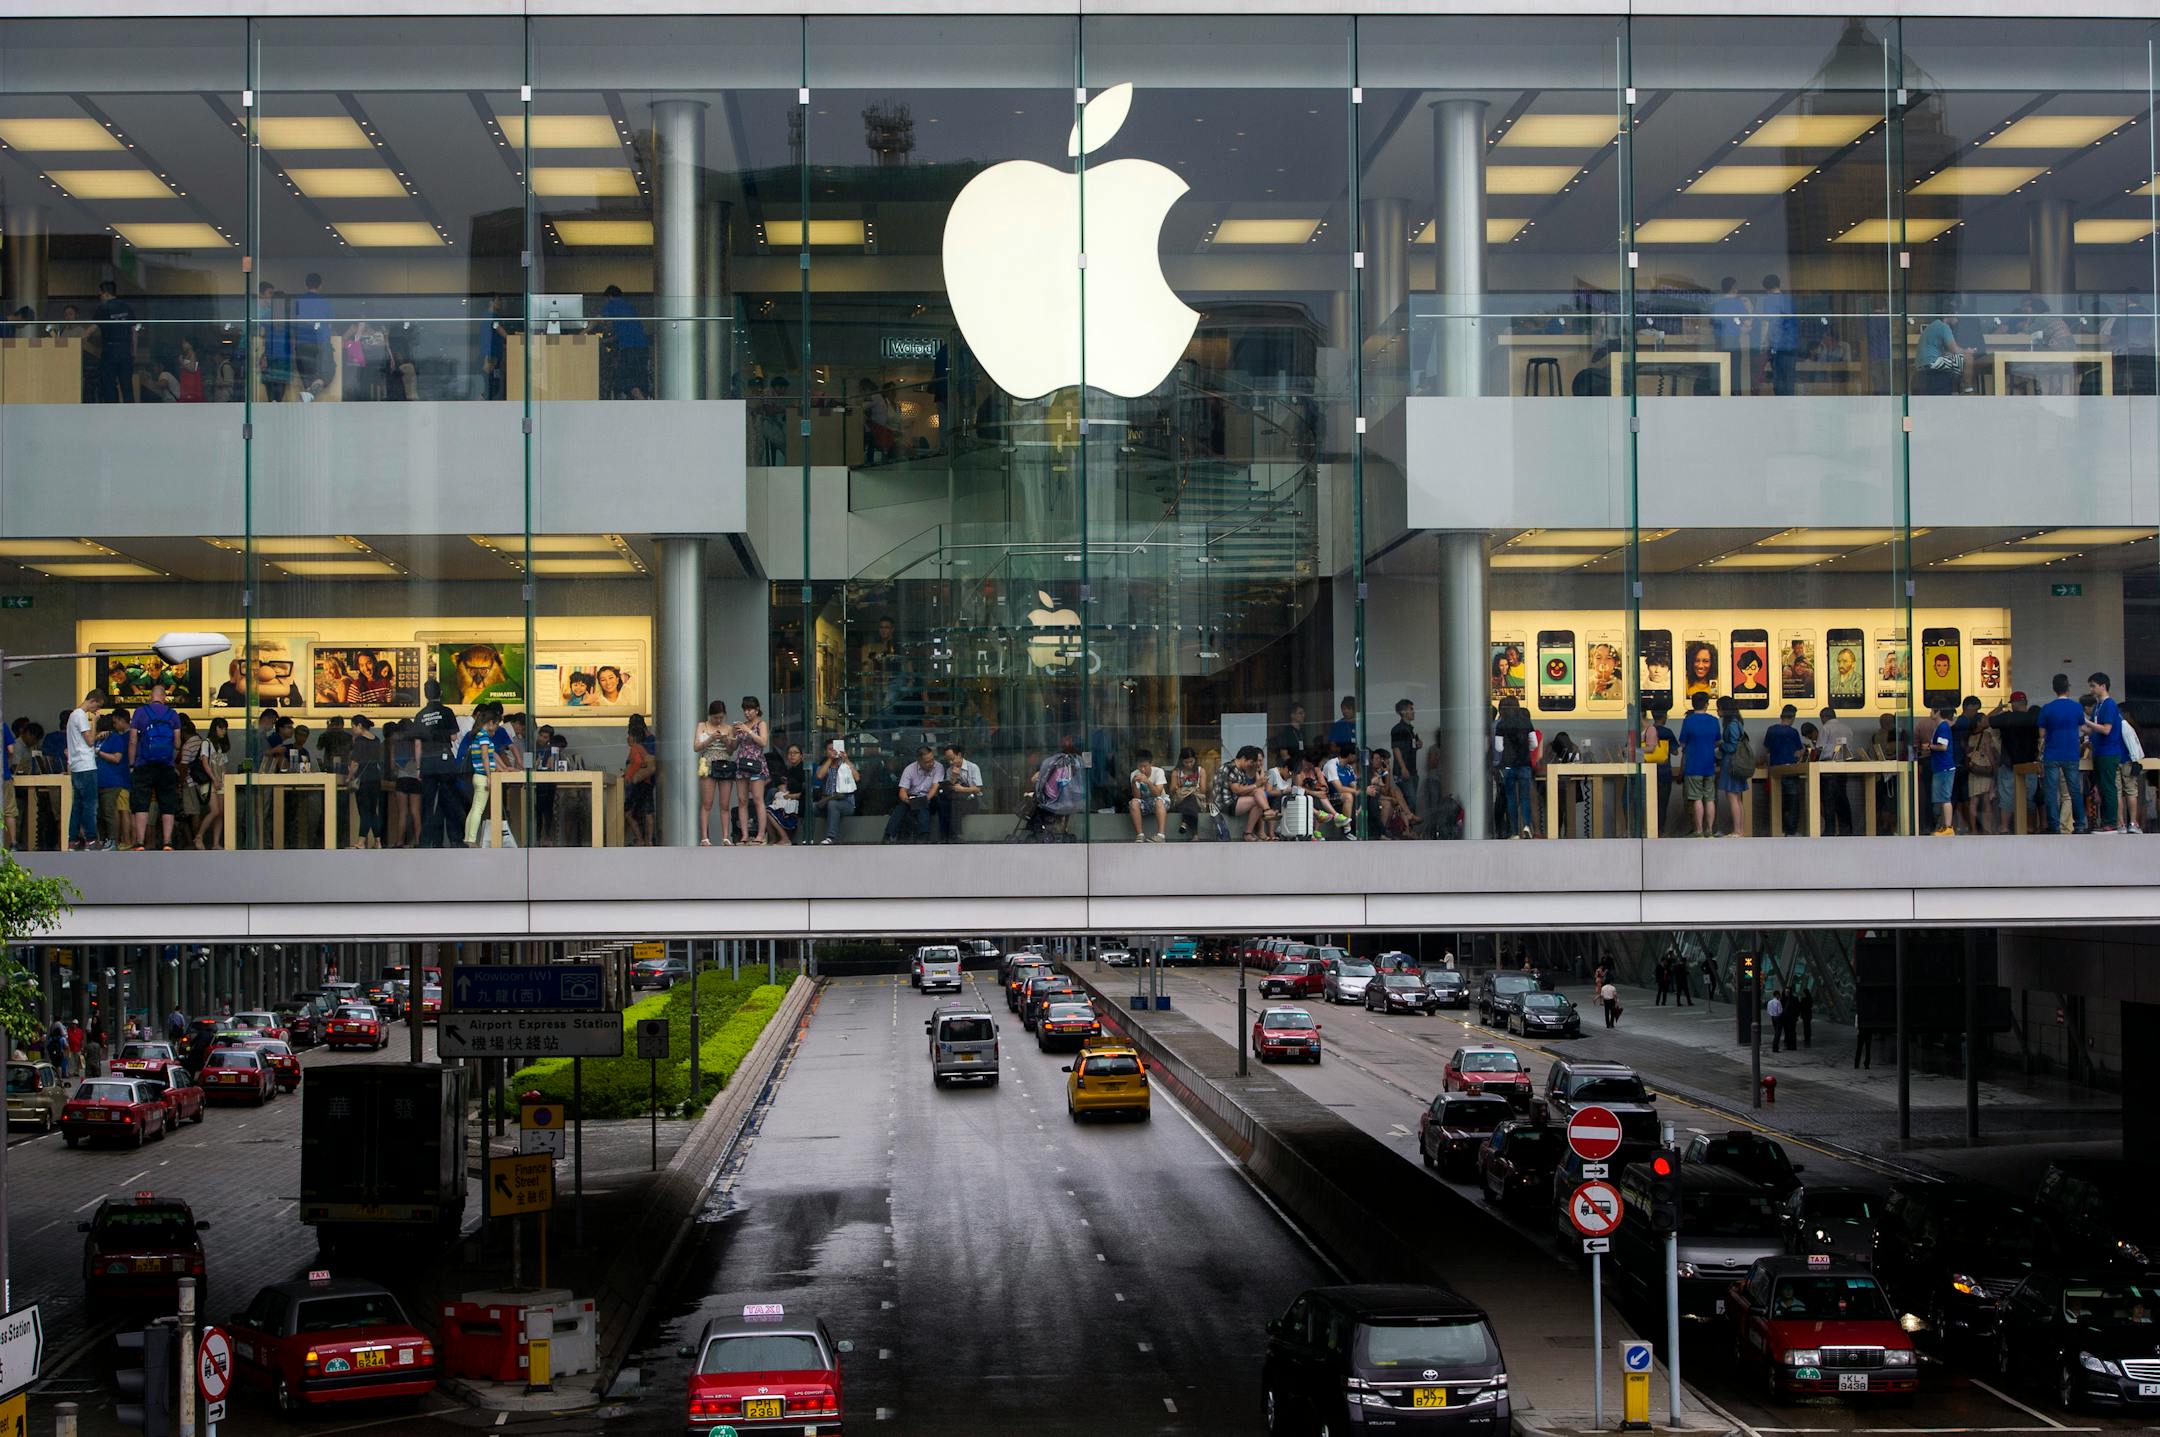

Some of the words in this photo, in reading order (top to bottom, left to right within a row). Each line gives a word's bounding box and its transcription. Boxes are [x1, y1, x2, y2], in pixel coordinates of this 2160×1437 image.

[474, 970, 525, 982] Kowloon
[529, 970, 553, 982] (W)
[471, 1019, 513, 1031] Airport
[519, 1019, 567, 1031] Express
[574, 1018, 618, 1029] Station
[549, 1131, 556, 1141] 7
[515, 1164, 547, 1176] Finance
[515, 1176, 539, 1187] Street
[311, 1271, 330, 1279] TAXI
[747, 1305, 781, 1314] TAXI
[9, 1320, 31, 1342] Station
[358, 1358, 384, 1367] 6244
[2144, 1386, 2157, 1394] FJ
[756, 1400, 772, 1408] PH
[1416, 1398, 1443, 1406] 8777
[750, 1408, 778, 1417] 2361
